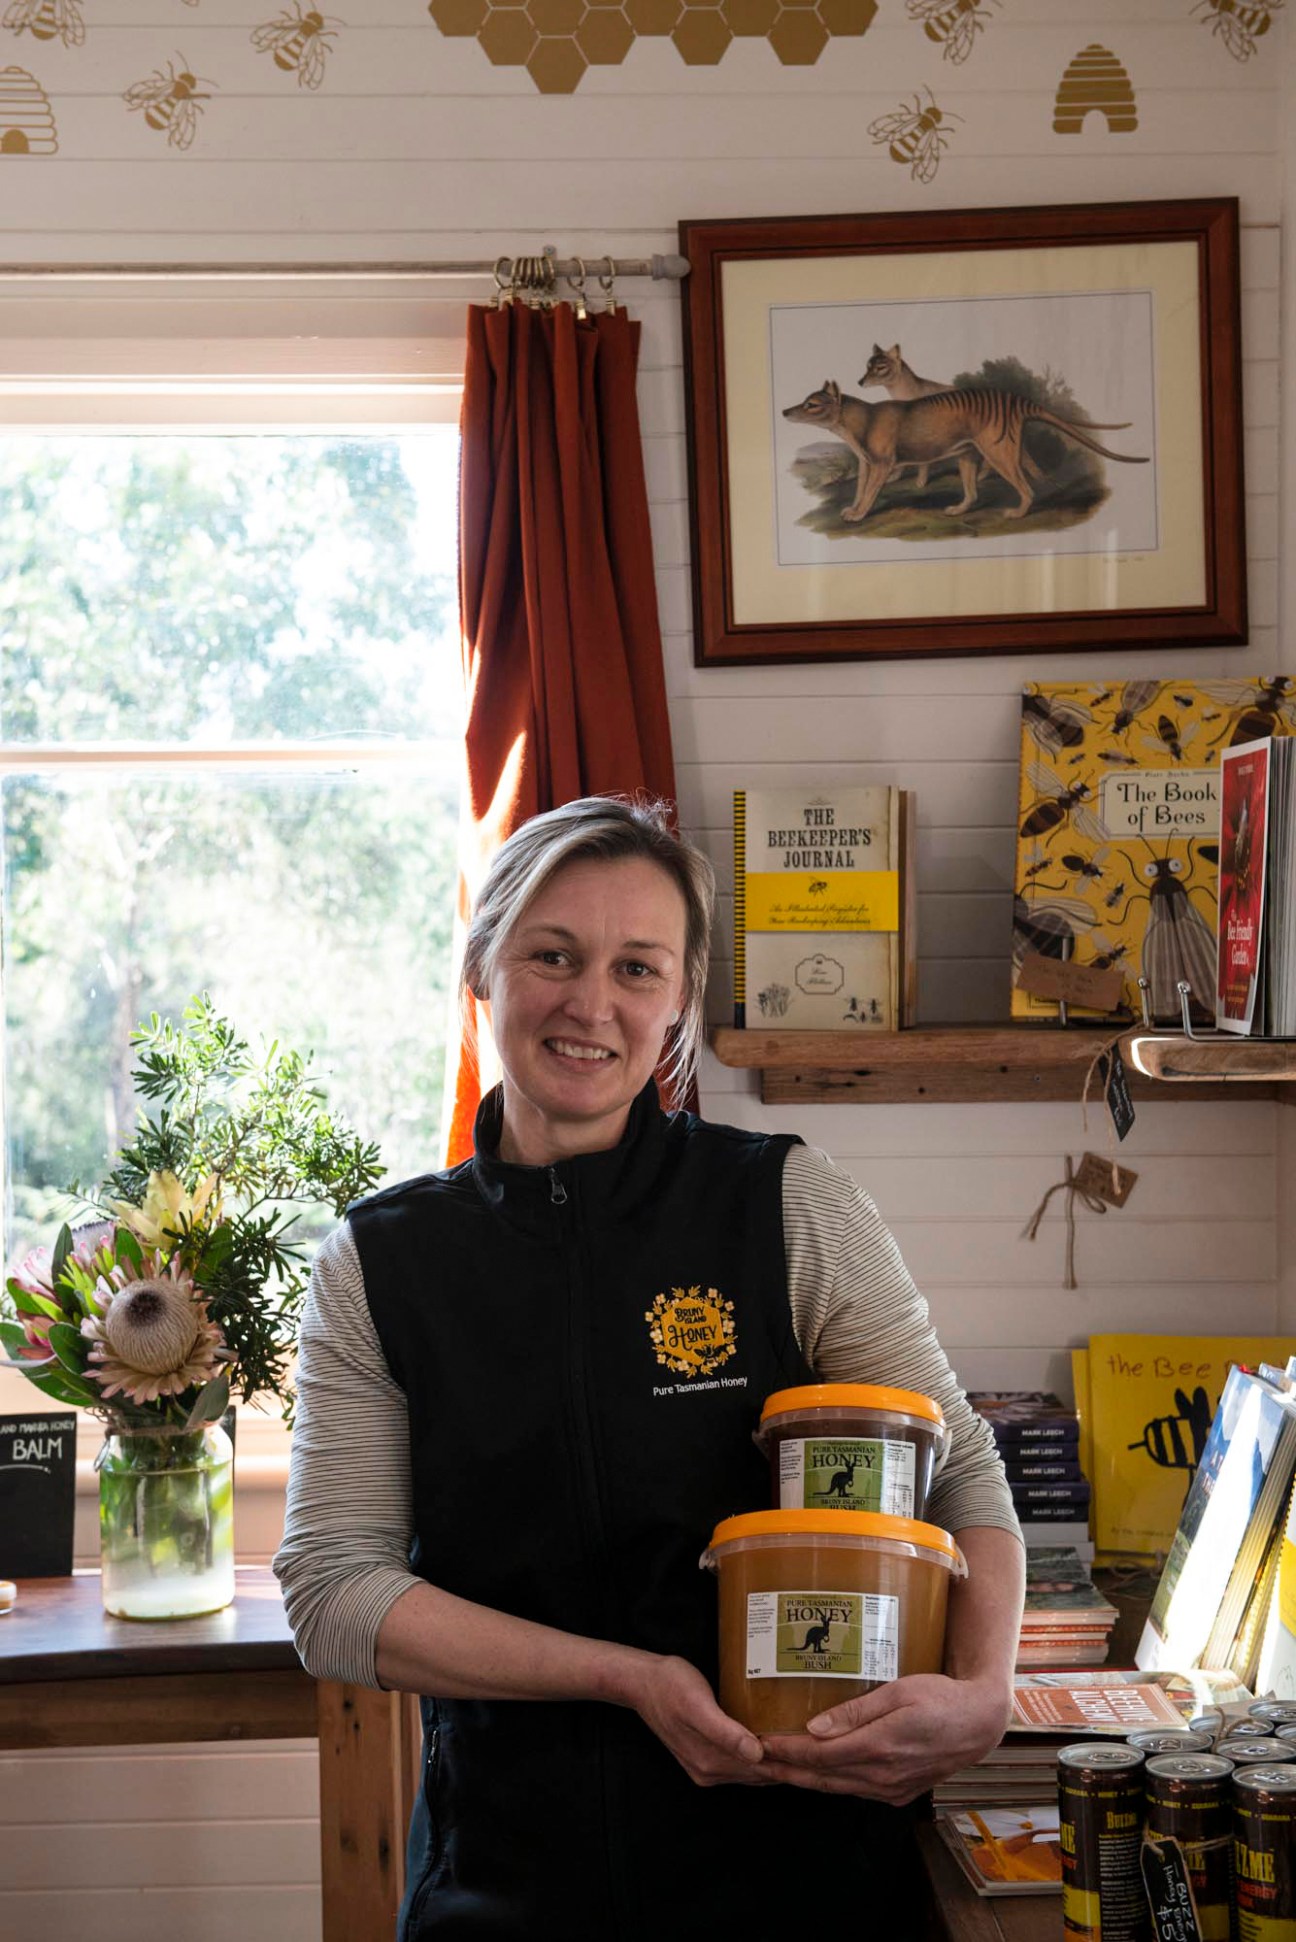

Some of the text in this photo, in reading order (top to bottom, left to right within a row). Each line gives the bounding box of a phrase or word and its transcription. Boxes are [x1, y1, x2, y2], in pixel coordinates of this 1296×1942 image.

[1117, 782, 1217, 802] The Book
[804, 809, 834, 825] THE
[1128, 805, 1206, 832] of Bees
[768, 829, 872, 847] BEEKEEPER'S
[784, 851, 855, 868] JOURNAL
[1108, 1354, 1143, 1377] the
[1153, 1356, 1211, 1378] Bee
[653, 1376, 748, 1396] Pure Tasmanian Honey
[12, 1436, 62, 1461] BALM
[812, 1454, 876, 1468] HONEY
[786, 1607, 852, 1623] HONEY
